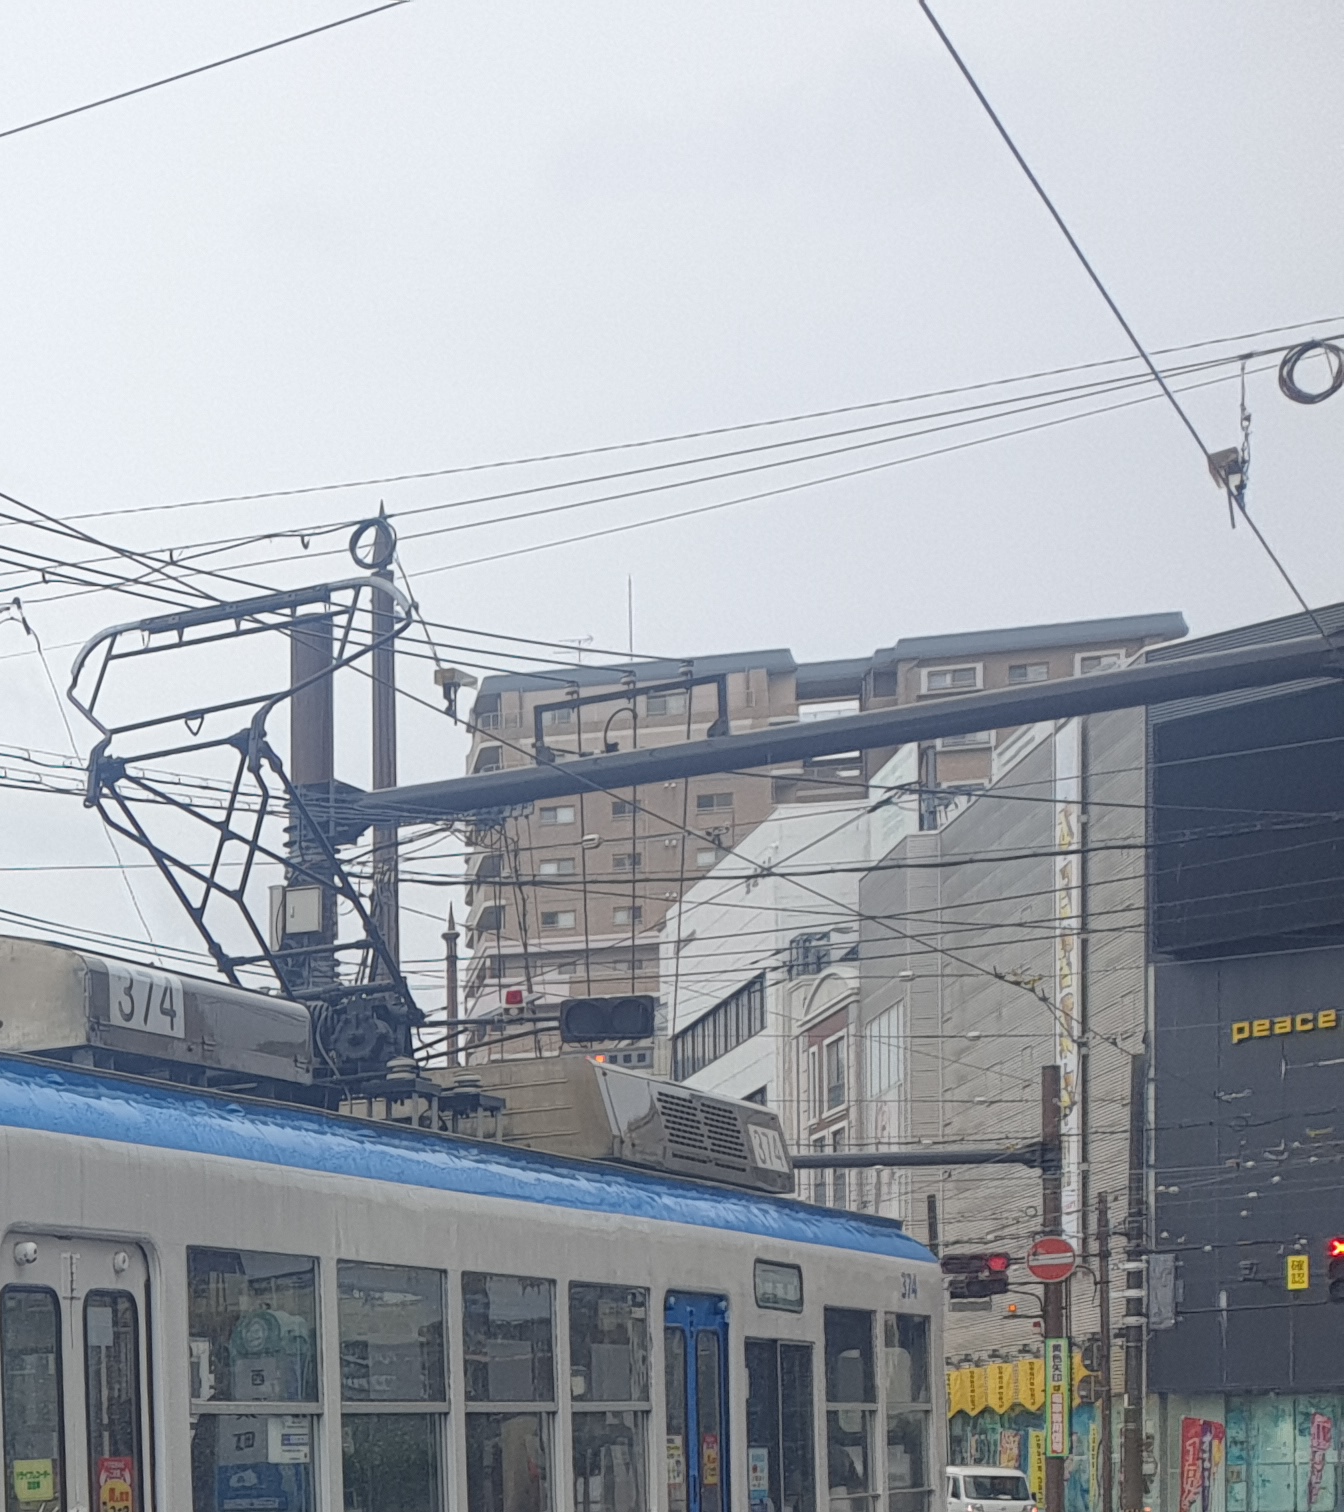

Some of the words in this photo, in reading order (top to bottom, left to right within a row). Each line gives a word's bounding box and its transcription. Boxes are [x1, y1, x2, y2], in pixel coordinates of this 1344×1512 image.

[118, 968, 177, 1031] 374
[1232, 1009, 1337, 1044] peace
[753, 1129, 785, 1168] 374
[901, 1271, 918, 1300] 374
